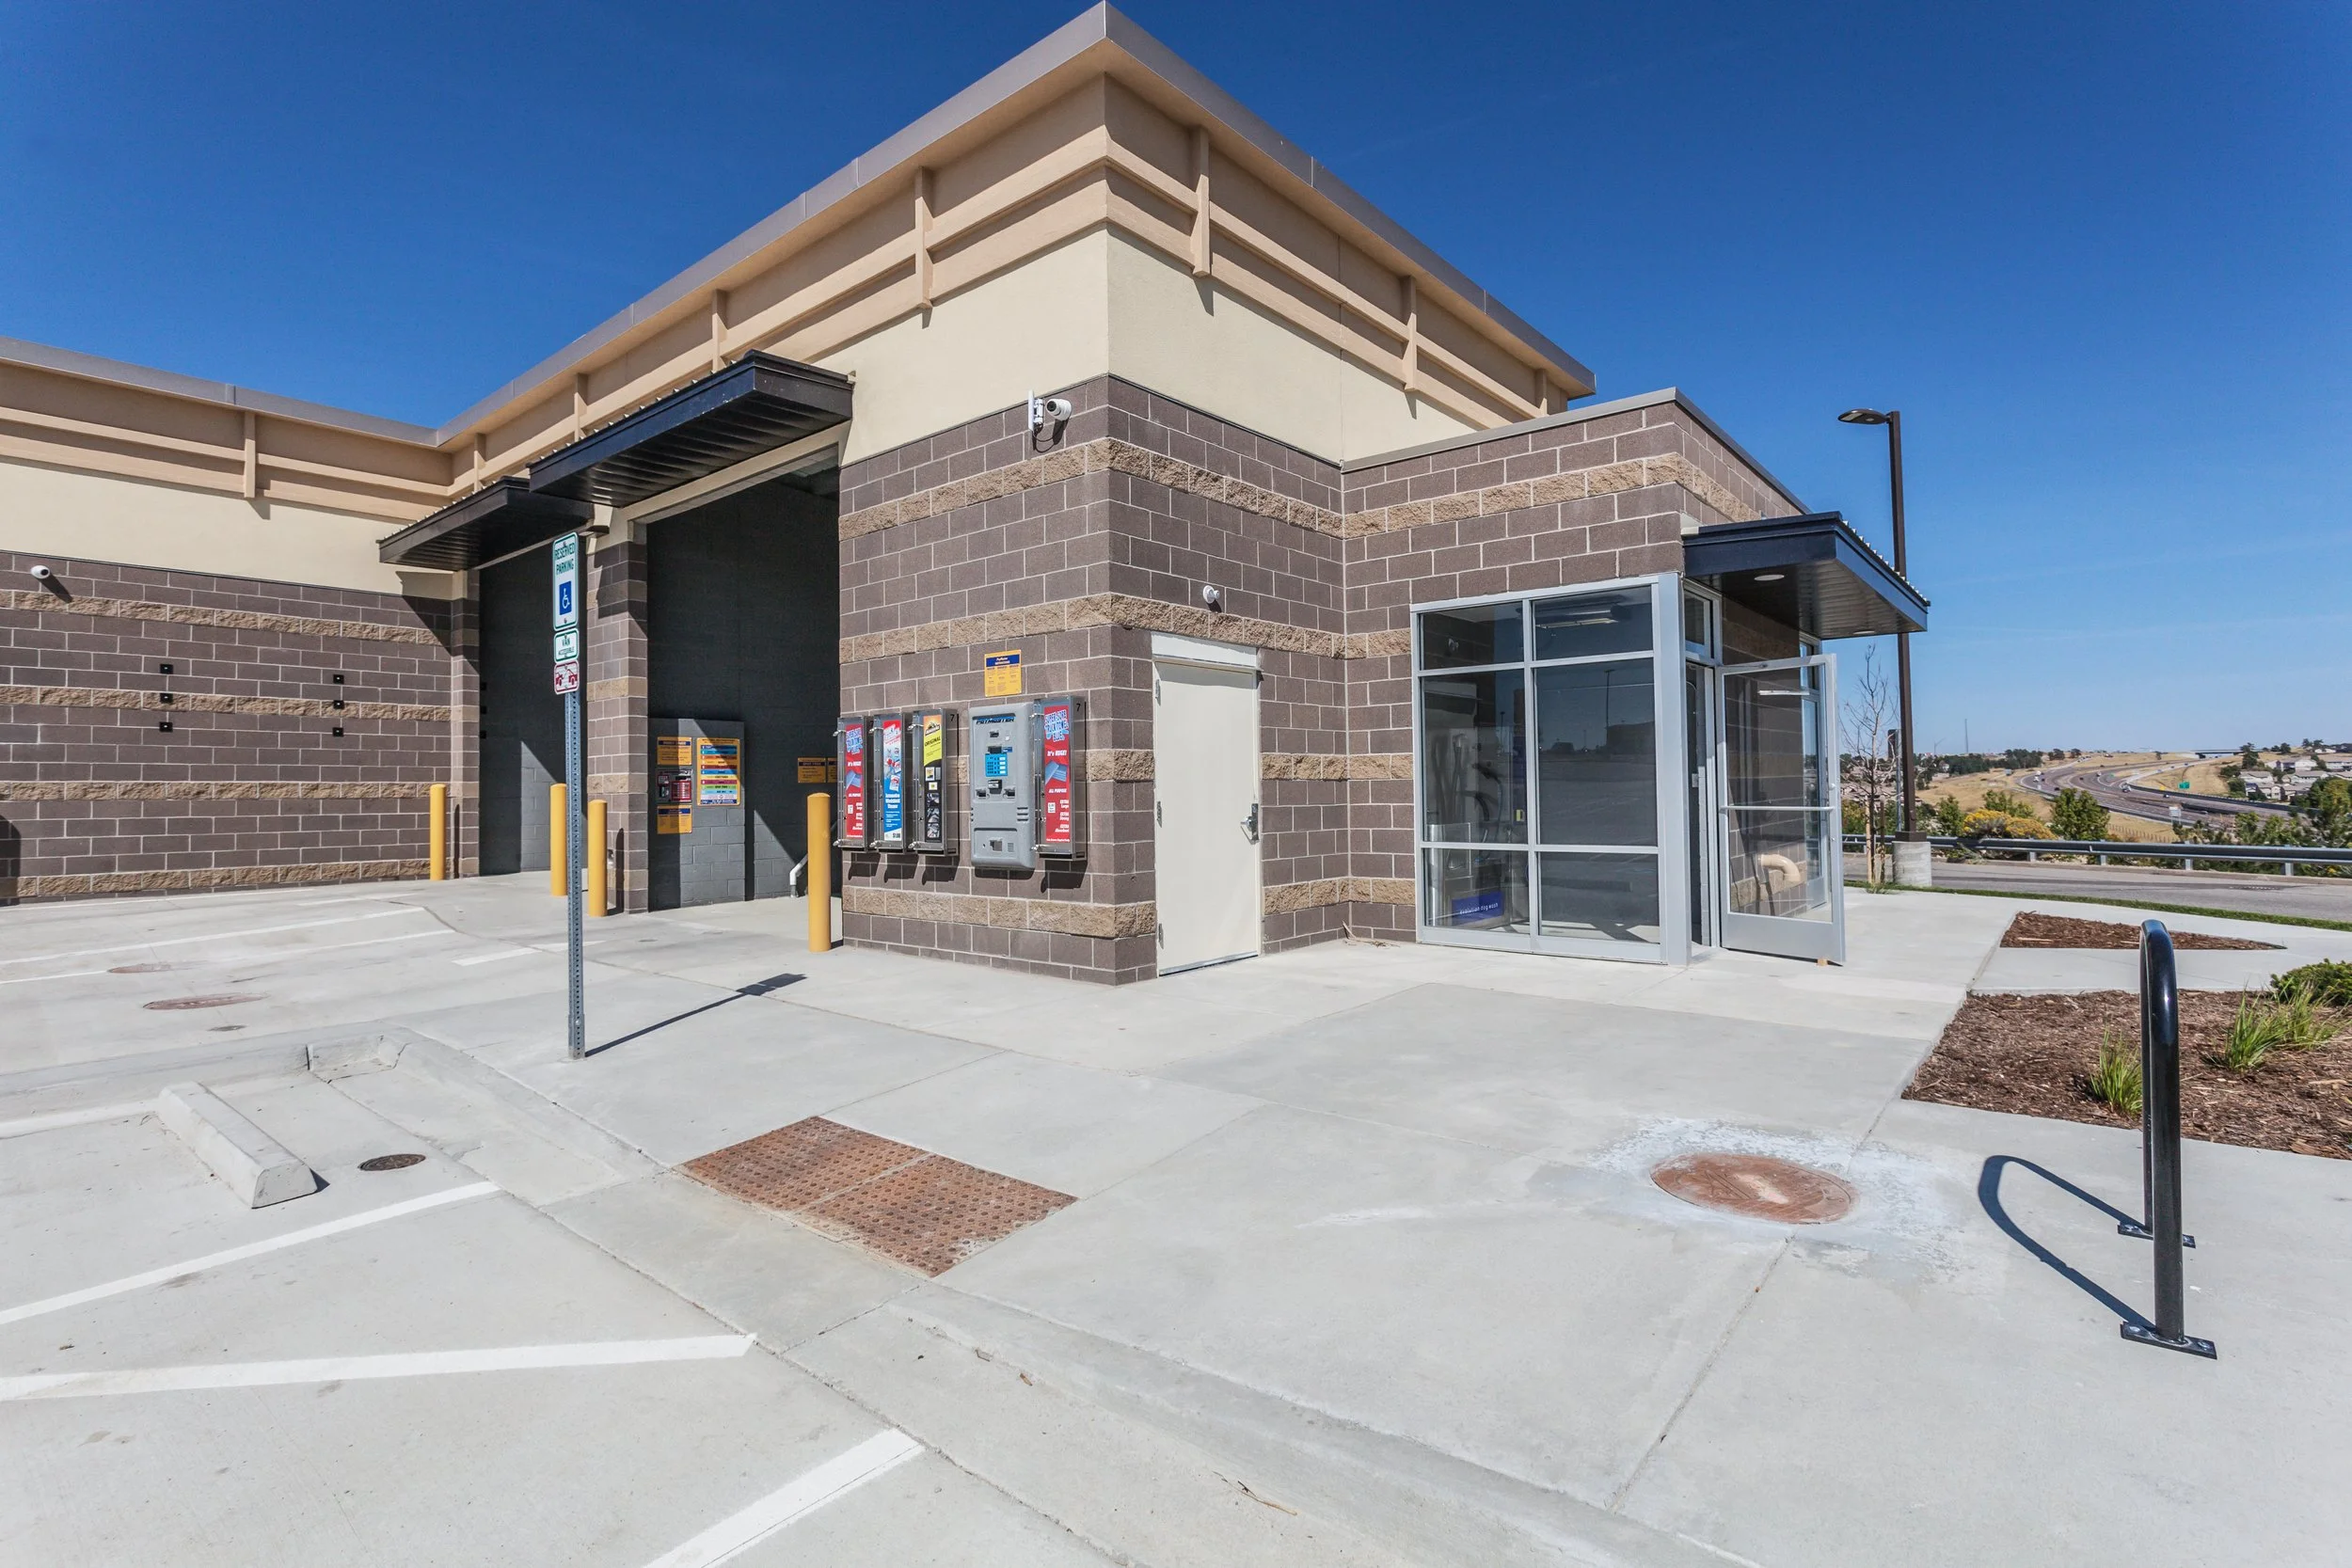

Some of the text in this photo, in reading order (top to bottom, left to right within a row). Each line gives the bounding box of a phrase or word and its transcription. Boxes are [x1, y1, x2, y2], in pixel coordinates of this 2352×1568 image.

[554, 543, 575, 561] RESERVED
[556, 559, 574, 575] PARKING
[562, 638, 570, 646] VAN
[1076, 704, 1081, 712] 7
[925, 736, 941, 747] ORIGINAL
